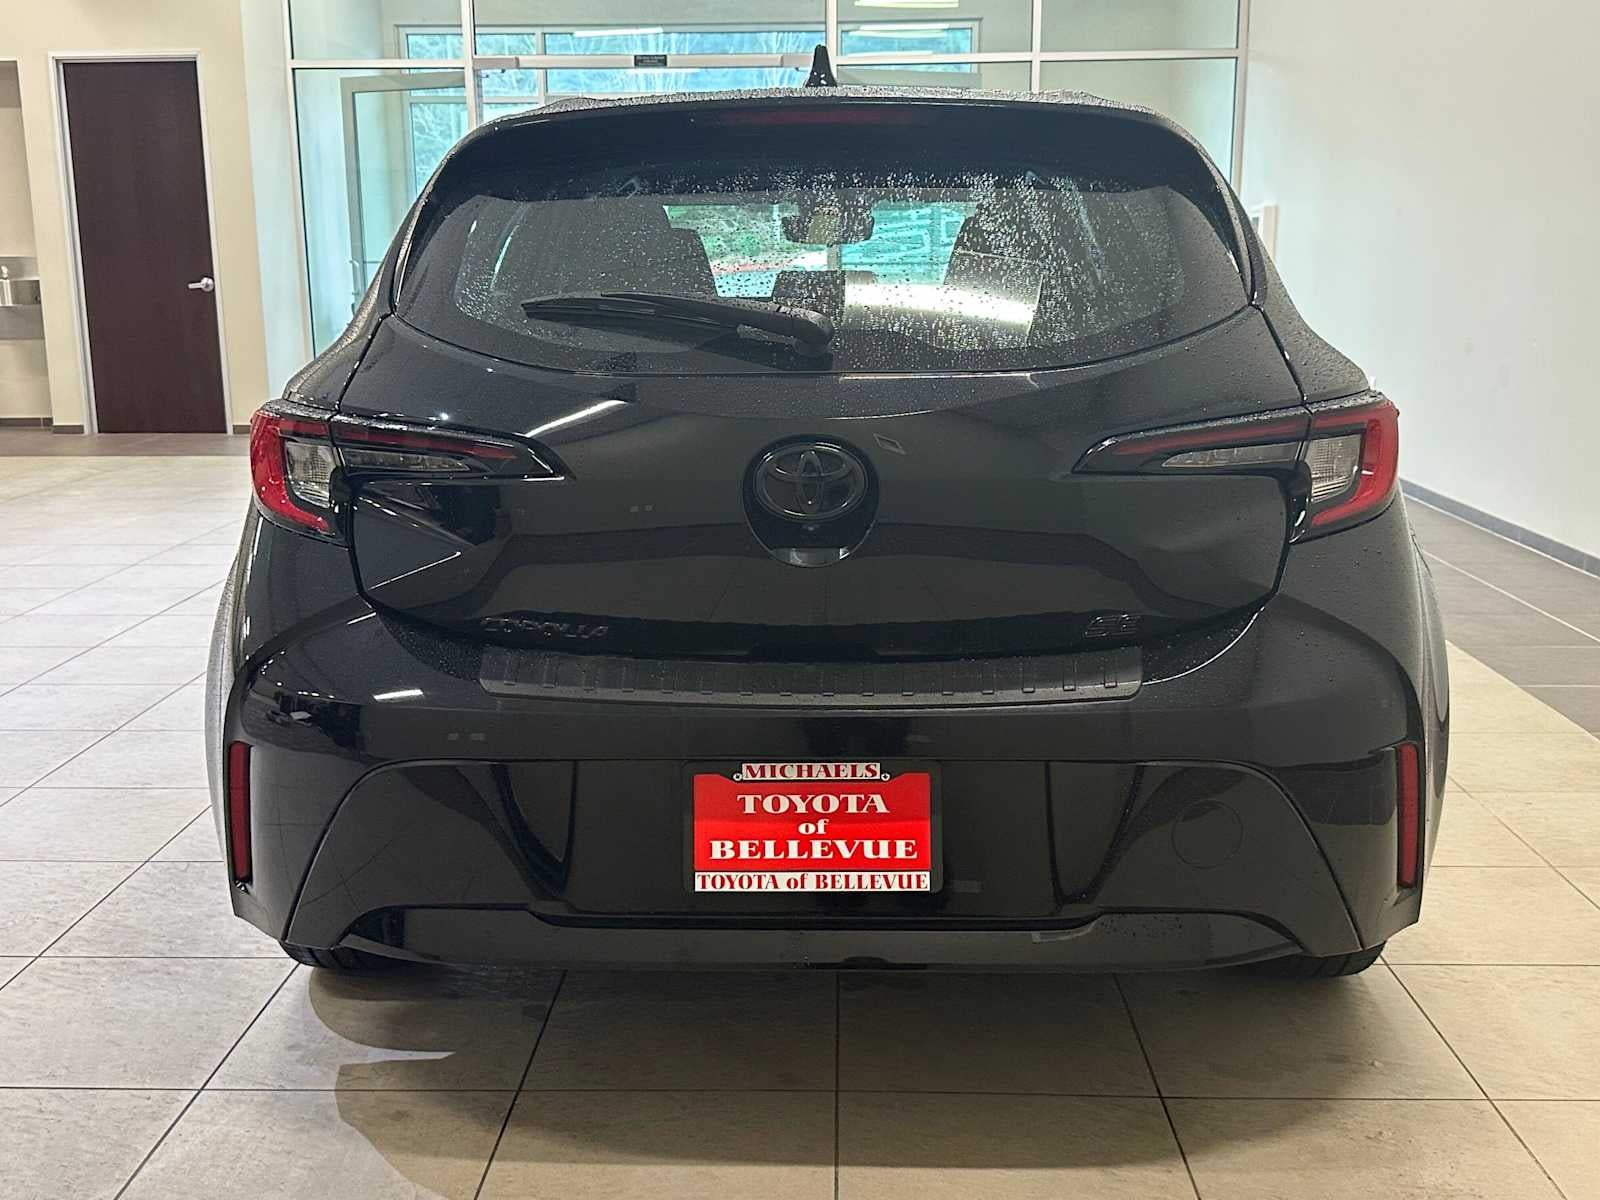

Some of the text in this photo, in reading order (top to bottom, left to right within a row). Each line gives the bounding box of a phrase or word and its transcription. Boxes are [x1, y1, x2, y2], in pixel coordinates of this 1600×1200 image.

[745, 764, 878, 778] MICHAELS
[737, 794, 890, 814] TOYOTA
[797, 818, 829, 835] of
[709, 839, 918, 860] BELLEVUE
[697, 873, 928, 890] TOYOTA of BELLEVUE
